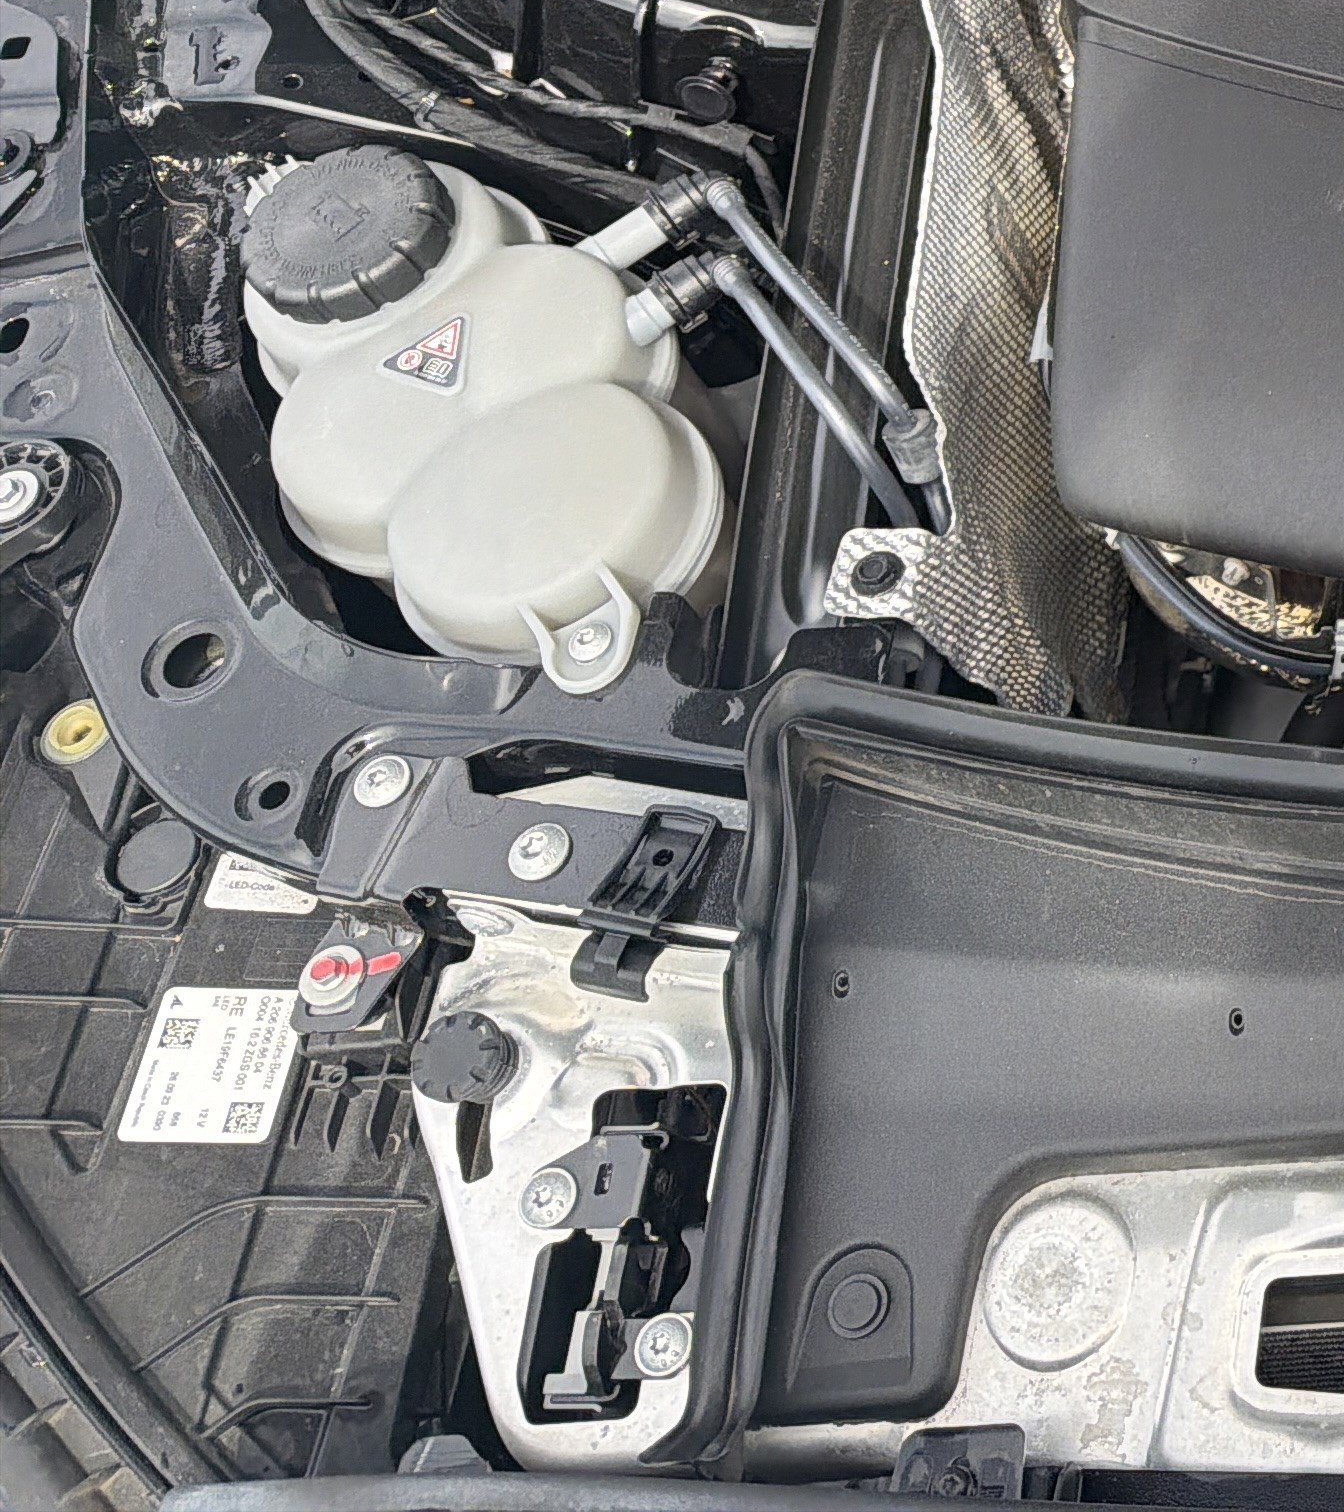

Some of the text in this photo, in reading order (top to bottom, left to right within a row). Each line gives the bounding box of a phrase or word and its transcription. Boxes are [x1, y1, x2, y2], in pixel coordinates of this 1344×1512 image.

[229, 995, 248, 1017] RE
[274, 996, 284, 1004] A
[234, 1072, 248, 1090] 001
